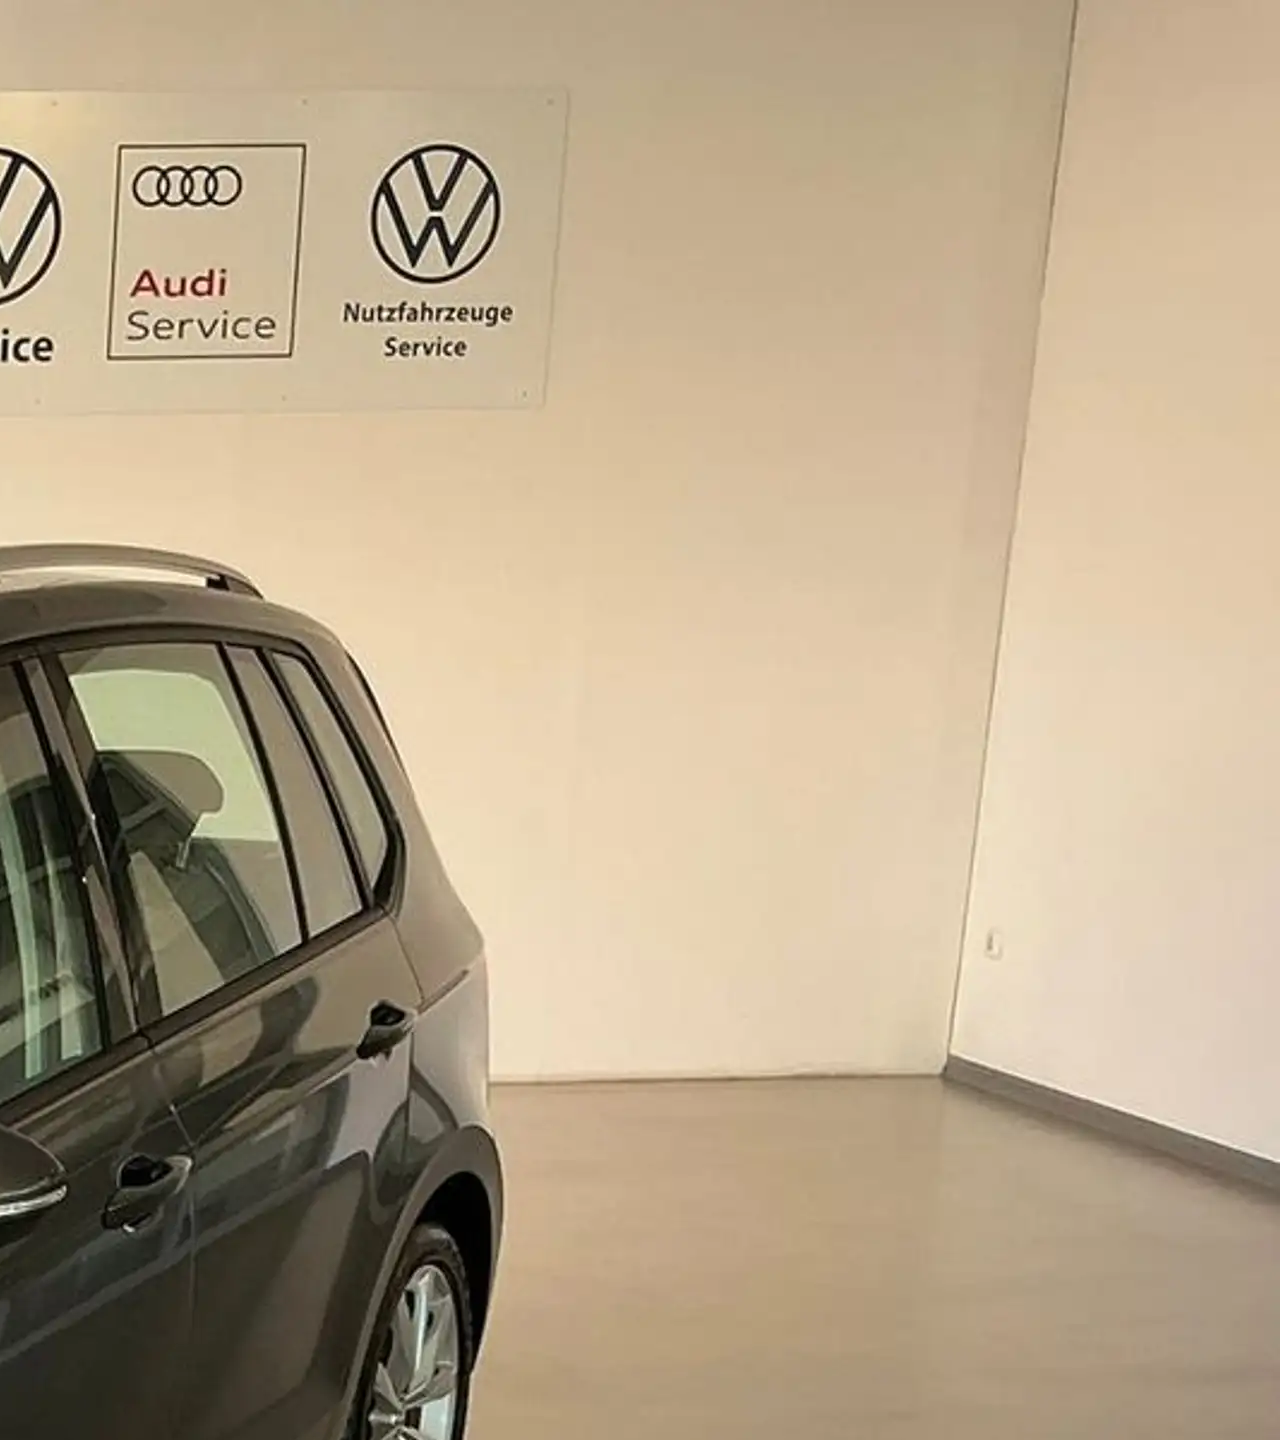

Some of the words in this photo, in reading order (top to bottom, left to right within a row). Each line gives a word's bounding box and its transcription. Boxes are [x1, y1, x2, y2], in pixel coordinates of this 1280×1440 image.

[130, 268, 228, 298] Audi
[126, 311, 277, 341] Service
[343, 301, 514, 327] Nutzfahrzeuge
[383, 335, 468, 358] Service
